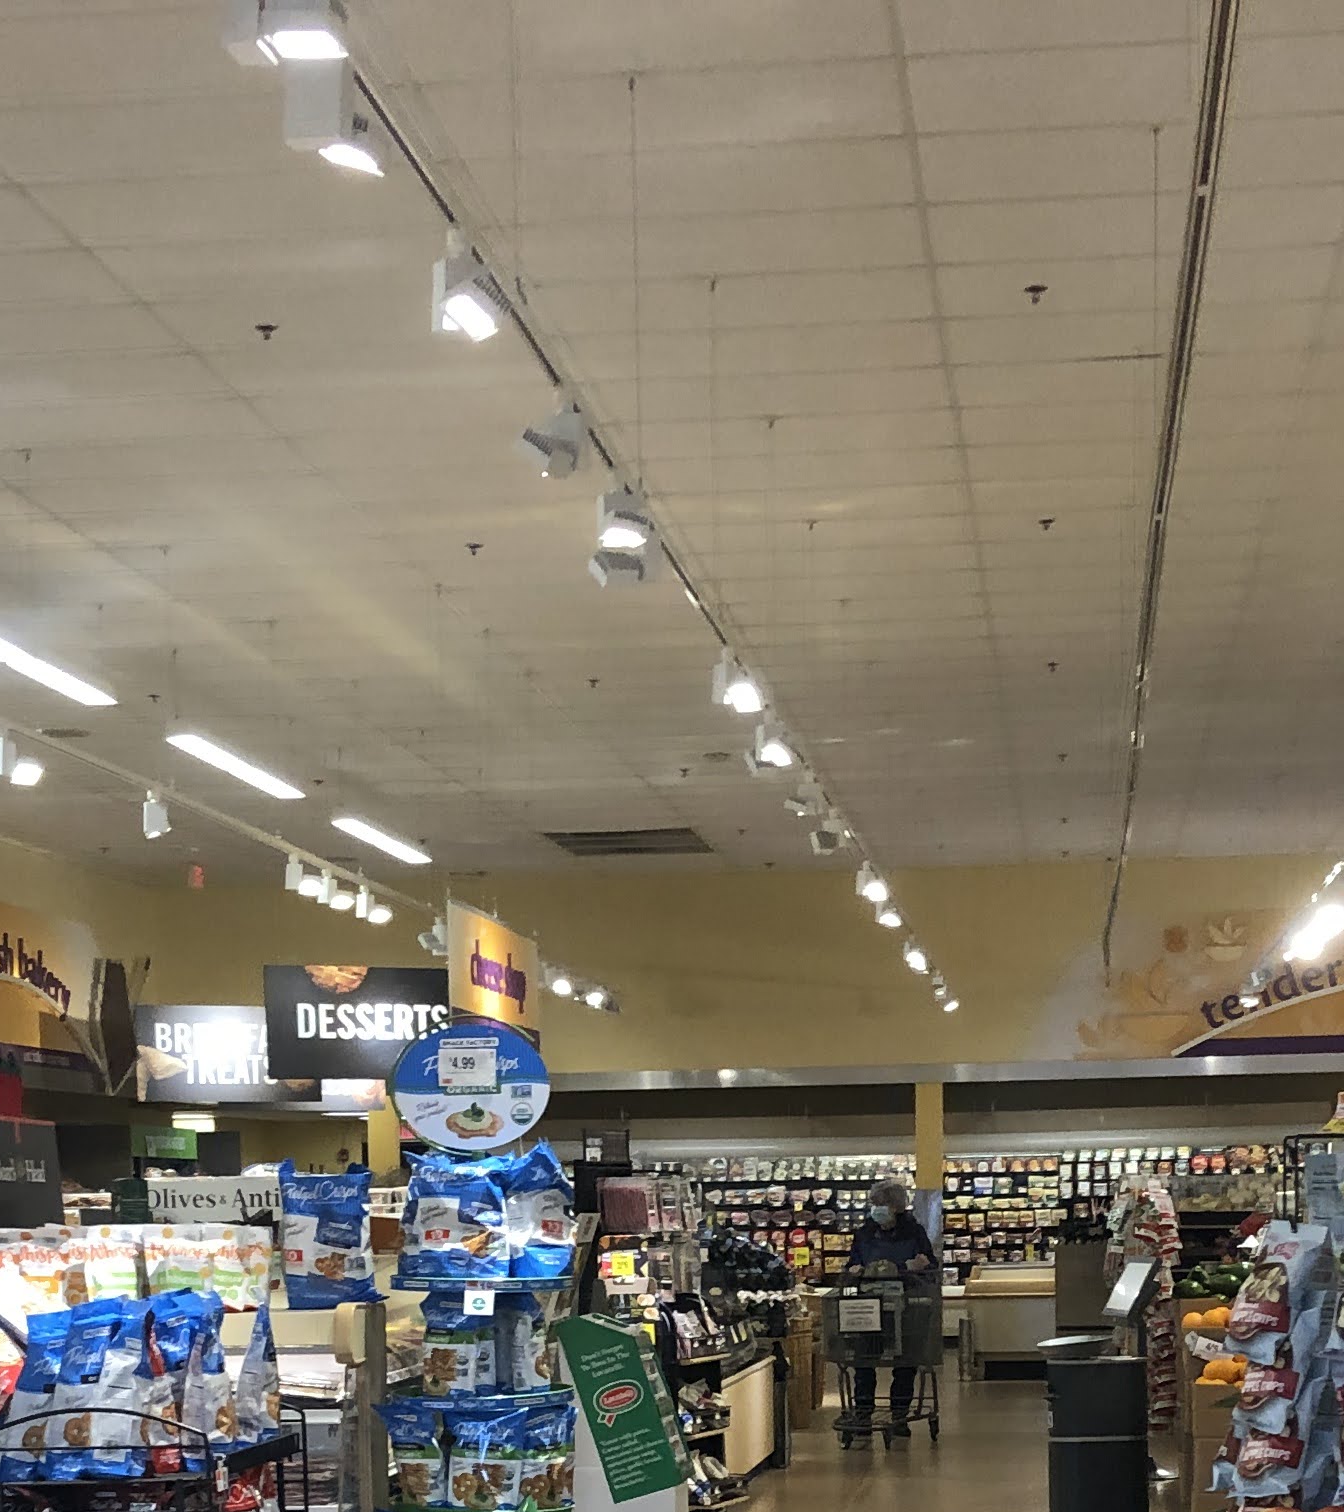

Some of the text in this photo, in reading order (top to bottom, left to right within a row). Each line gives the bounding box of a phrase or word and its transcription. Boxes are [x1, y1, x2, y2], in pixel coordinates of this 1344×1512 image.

[297, 1001, 449, 1041] DESSERTS
[147, 1188, 221, 1209] Olives
[232, 1188, 281, 1209] Anti
